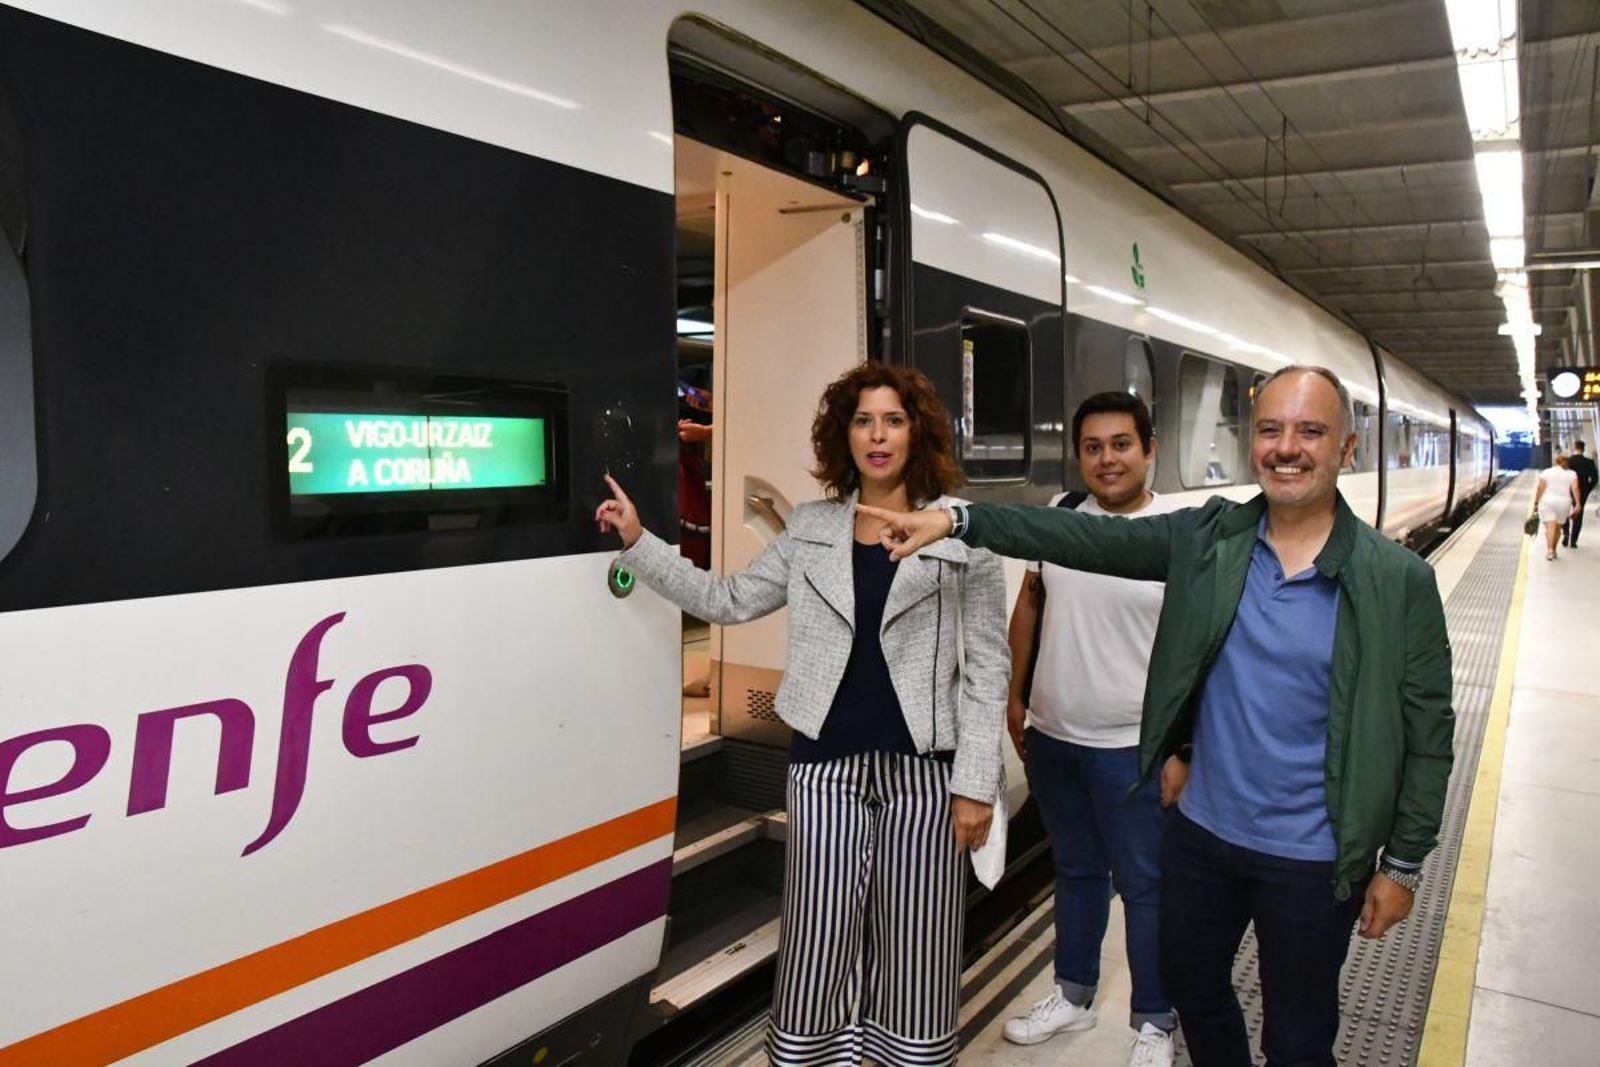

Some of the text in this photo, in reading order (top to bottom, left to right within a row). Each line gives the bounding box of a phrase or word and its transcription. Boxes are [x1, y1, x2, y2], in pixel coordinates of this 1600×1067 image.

[287, 427, 313, 473] 2
[345, 420, 493, 448] VIGO-URZAIZ
[348, 452, 471, 486] A CORUÑA
